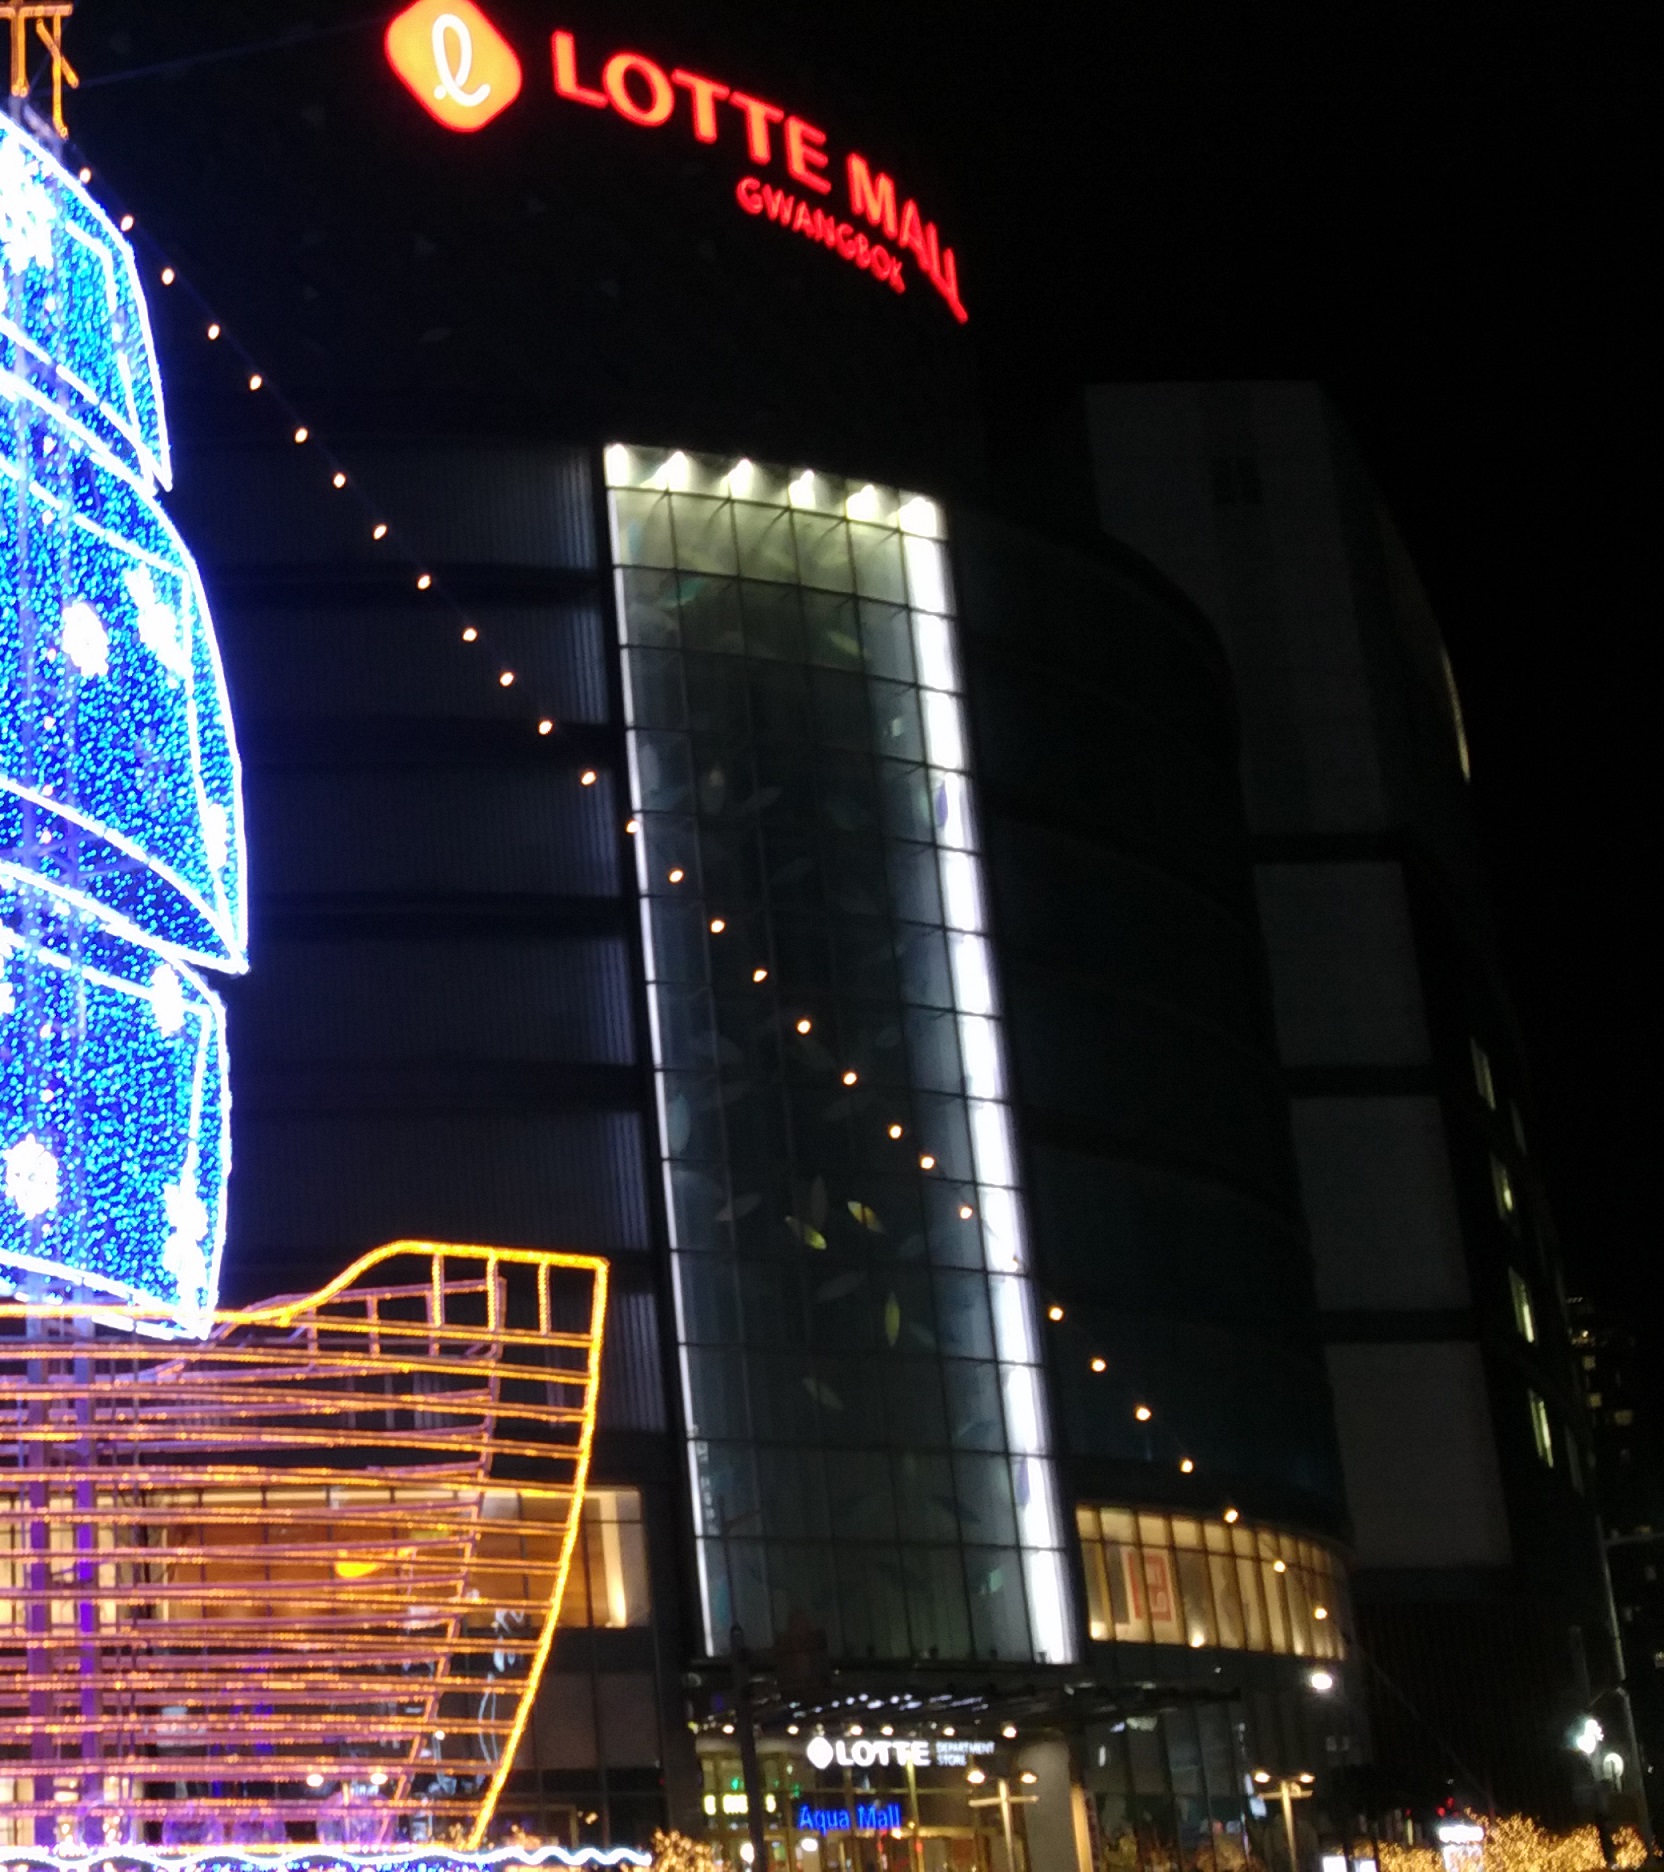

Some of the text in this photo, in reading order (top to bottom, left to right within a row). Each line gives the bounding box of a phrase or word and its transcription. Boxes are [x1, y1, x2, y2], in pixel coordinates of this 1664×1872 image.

[550, 29, 969, 324] LOTTE MALL
[736, 176, 906, 294] GWANGBOK
[835, 1739, 931, 1767] LOTTE
[935, 1741, 995, 1755] DEPARTMENT
[937, 1754, 967, 1766] STORE
[798, 1804, 850, 1836] Aqua
[857, 1802, 901, 1829] Mall
